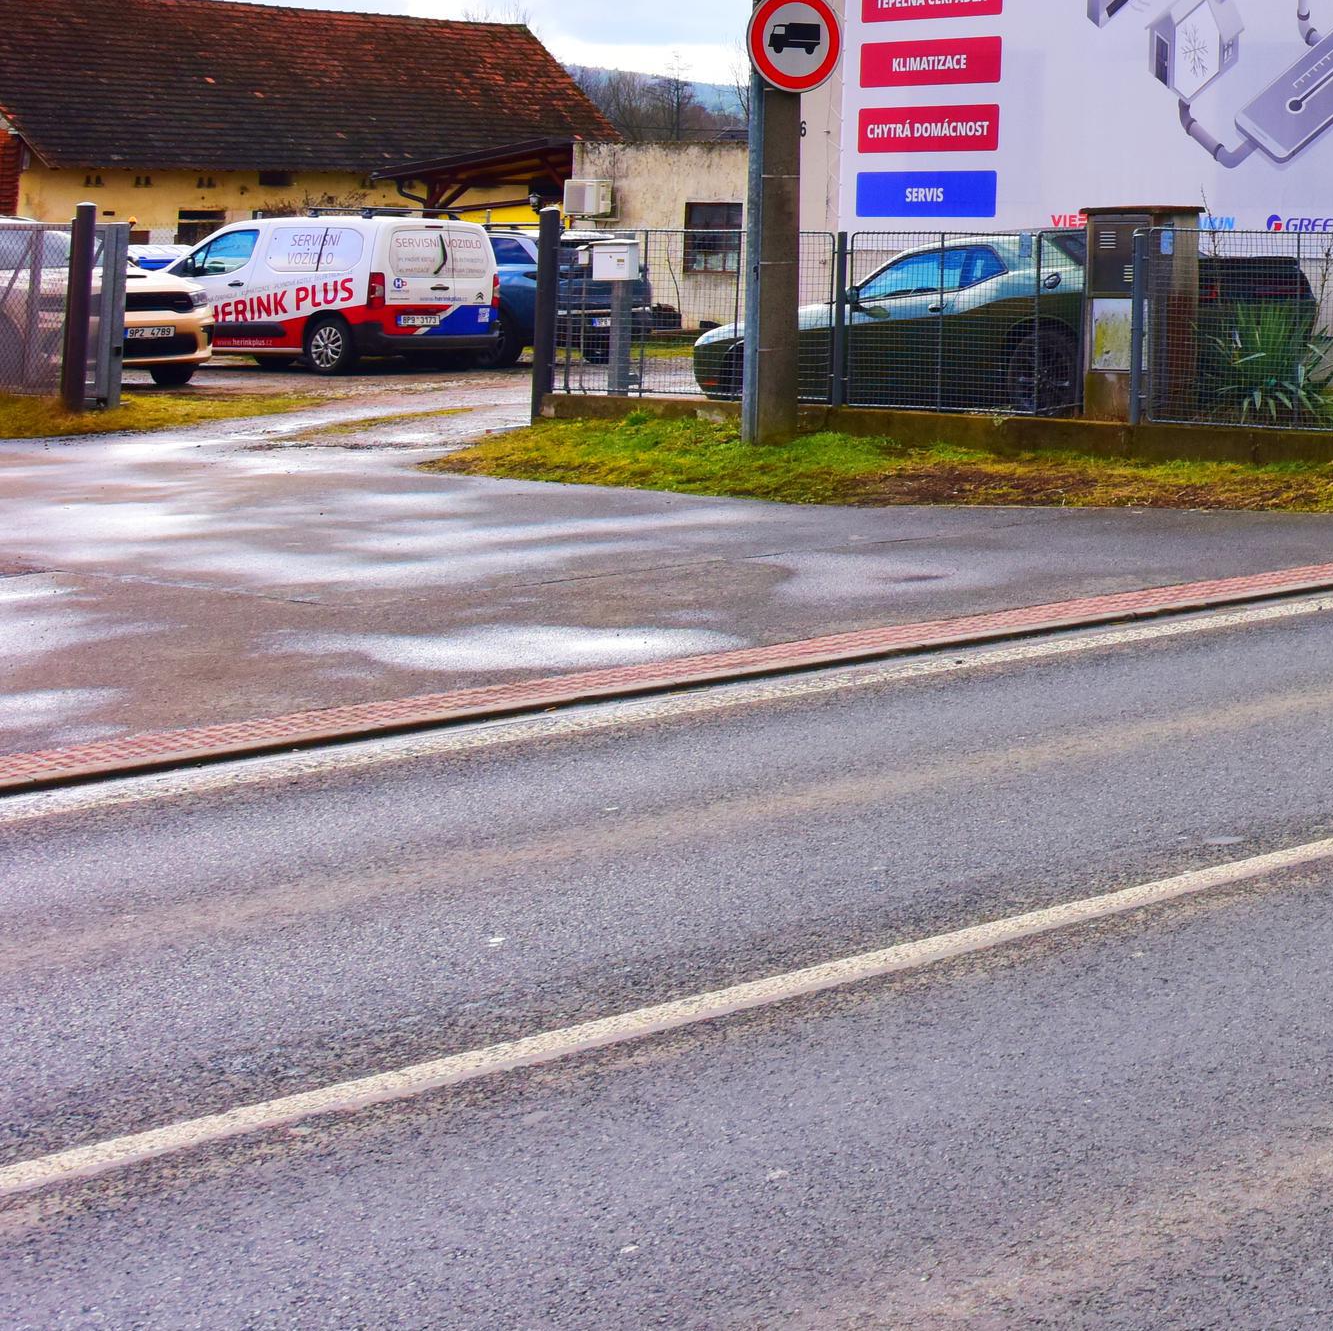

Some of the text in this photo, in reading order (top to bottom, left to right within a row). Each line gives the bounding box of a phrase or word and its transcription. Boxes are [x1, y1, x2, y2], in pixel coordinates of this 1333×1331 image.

[892, 54, 967, 72] KLIMATIZACE
[867, 118, 989, 139] CHYTRÁ DOMÁCNOST
[905, 187, 944, 203] SERVIS
[290, 231, 343, 247] SERVISNÍ
[395, 236, 482, 249] SERVISNÍ VOZIDLO
[287, 252, 334, 266] VOZIDLO
[295, 277, 354, 311] PLUS
[129, 327, 171, 338] 9P2 4789
